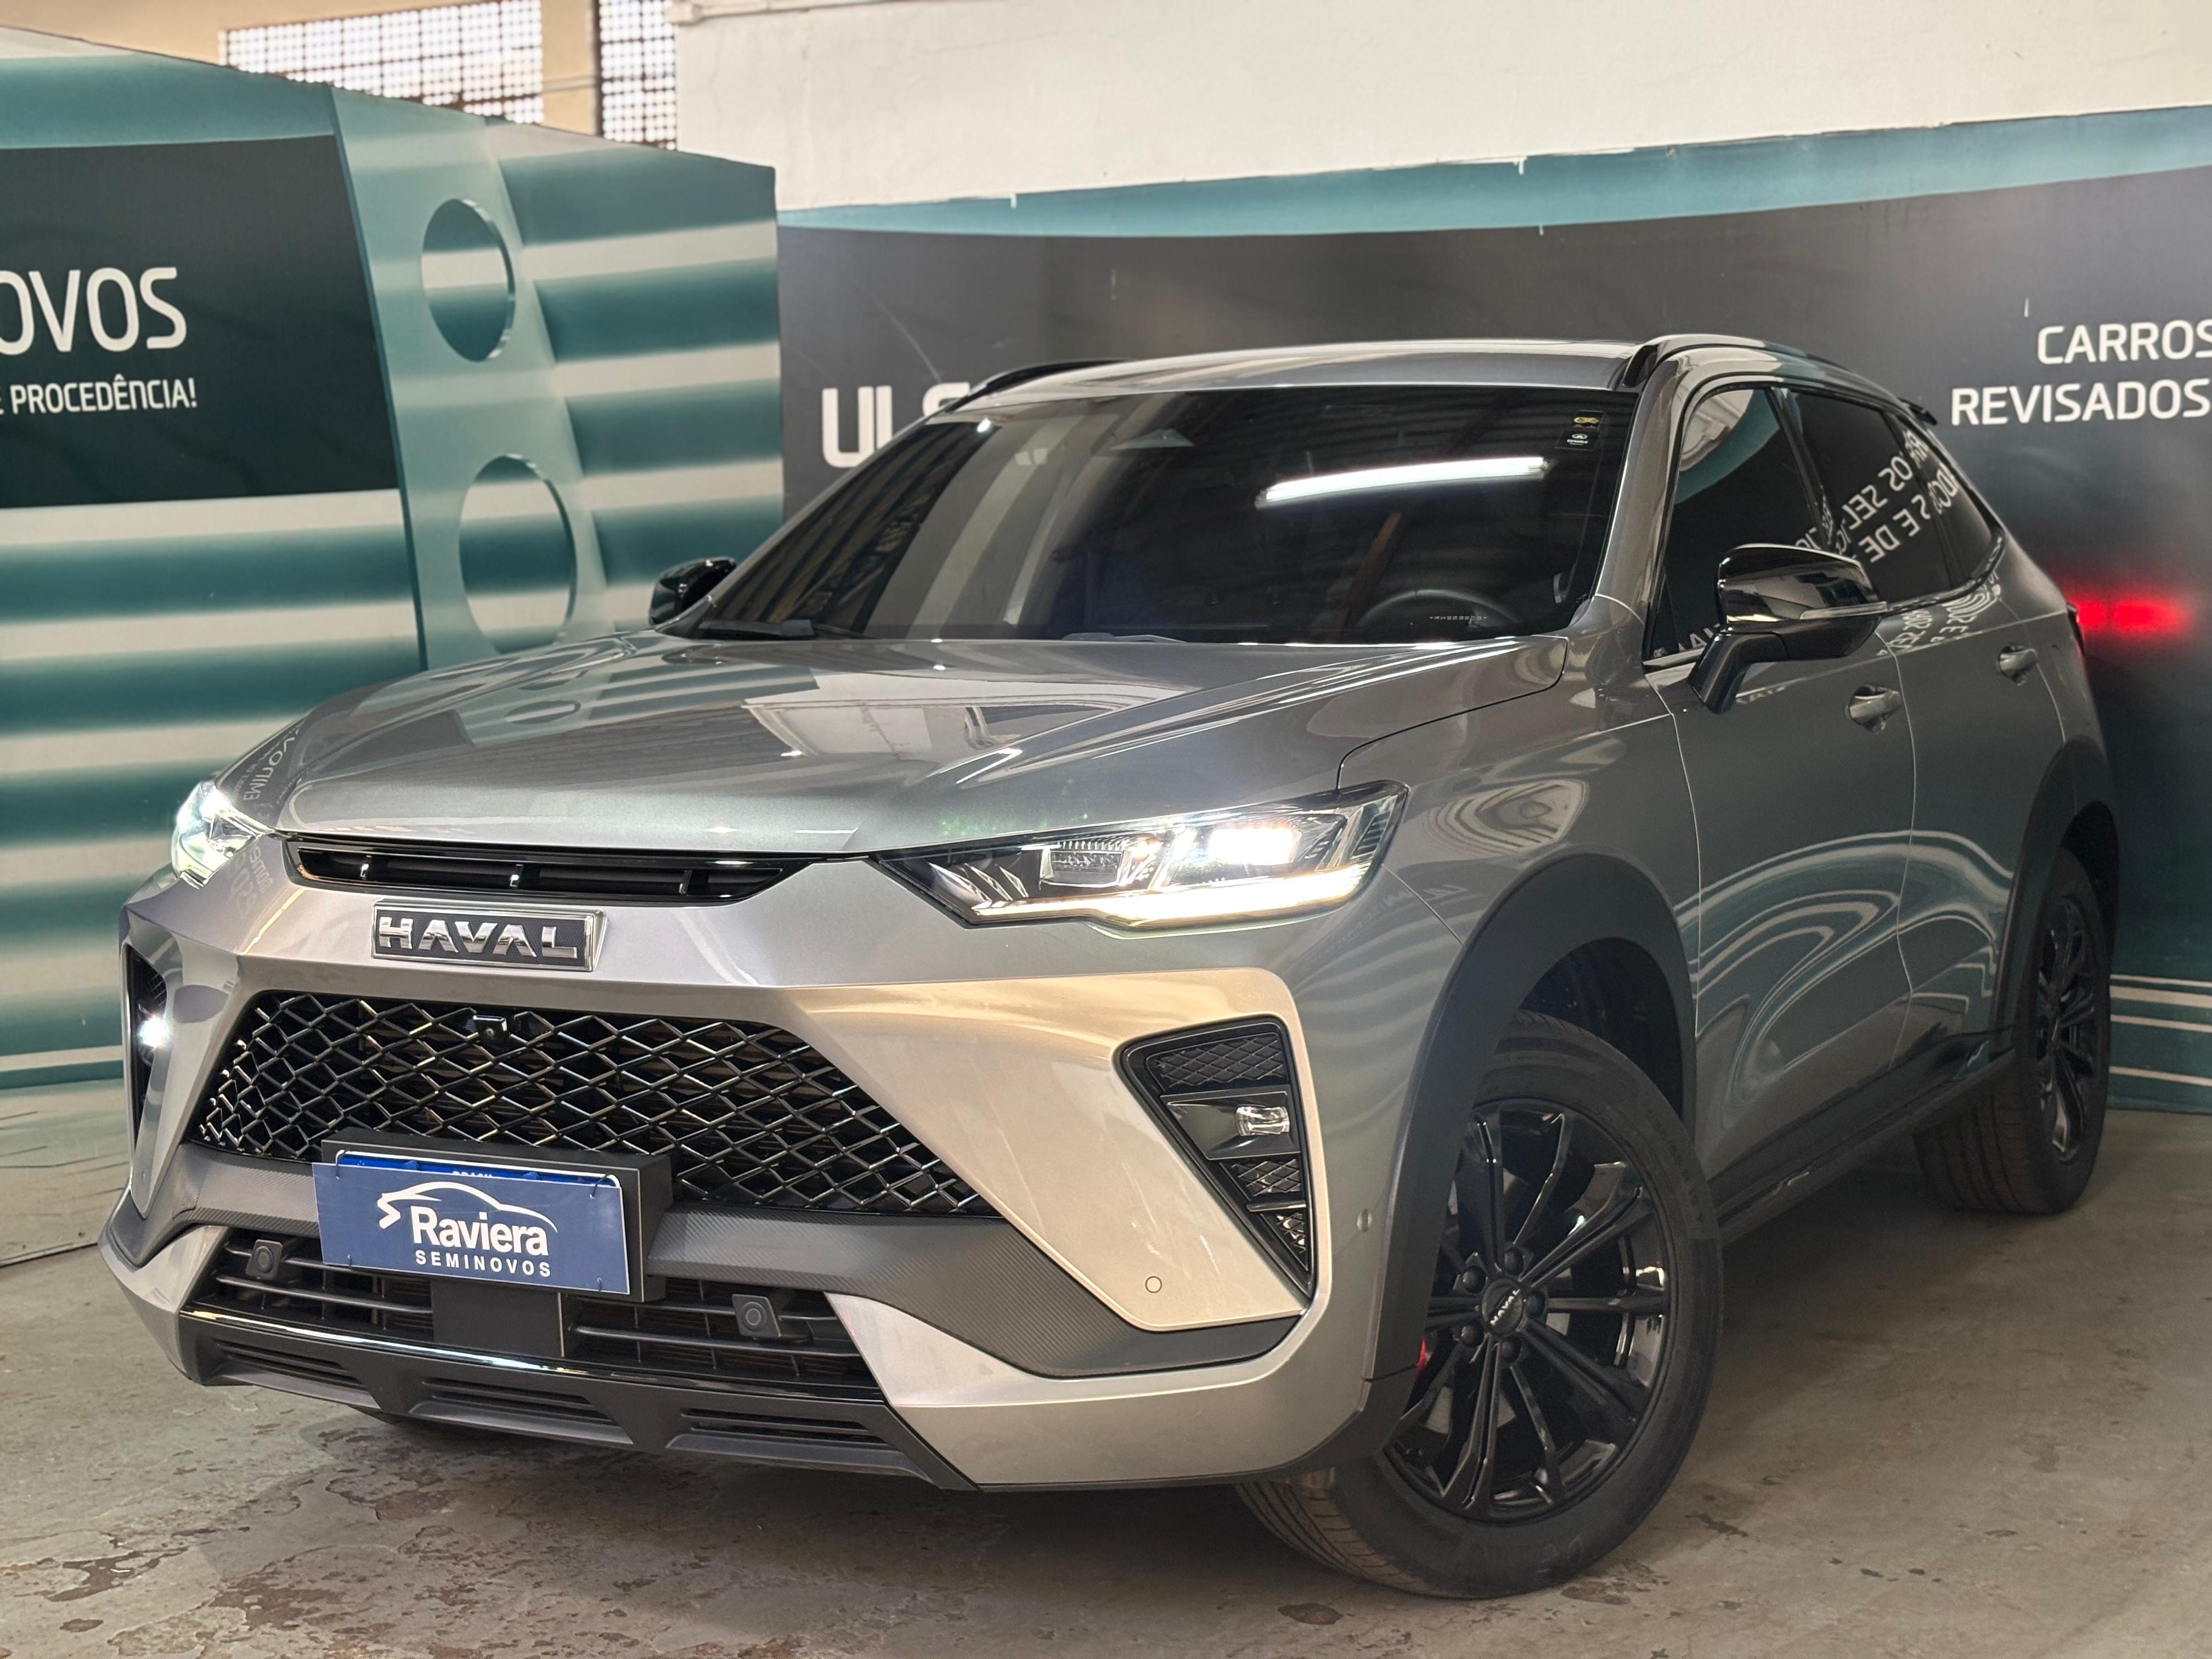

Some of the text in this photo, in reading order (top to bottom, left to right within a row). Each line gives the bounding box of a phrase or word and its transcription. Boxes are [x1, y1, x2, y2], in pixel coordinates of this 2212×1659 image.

[10, 374, 198, 415] PROCEDÊNCIA!
[1951, 378, 2211, 426] REVISADOS
[379, 916, 578, 960] HAVAL
[410, 1205, 549, 1256] Raviera
[415, 1249, 551, 1277] SEMINOVOS
